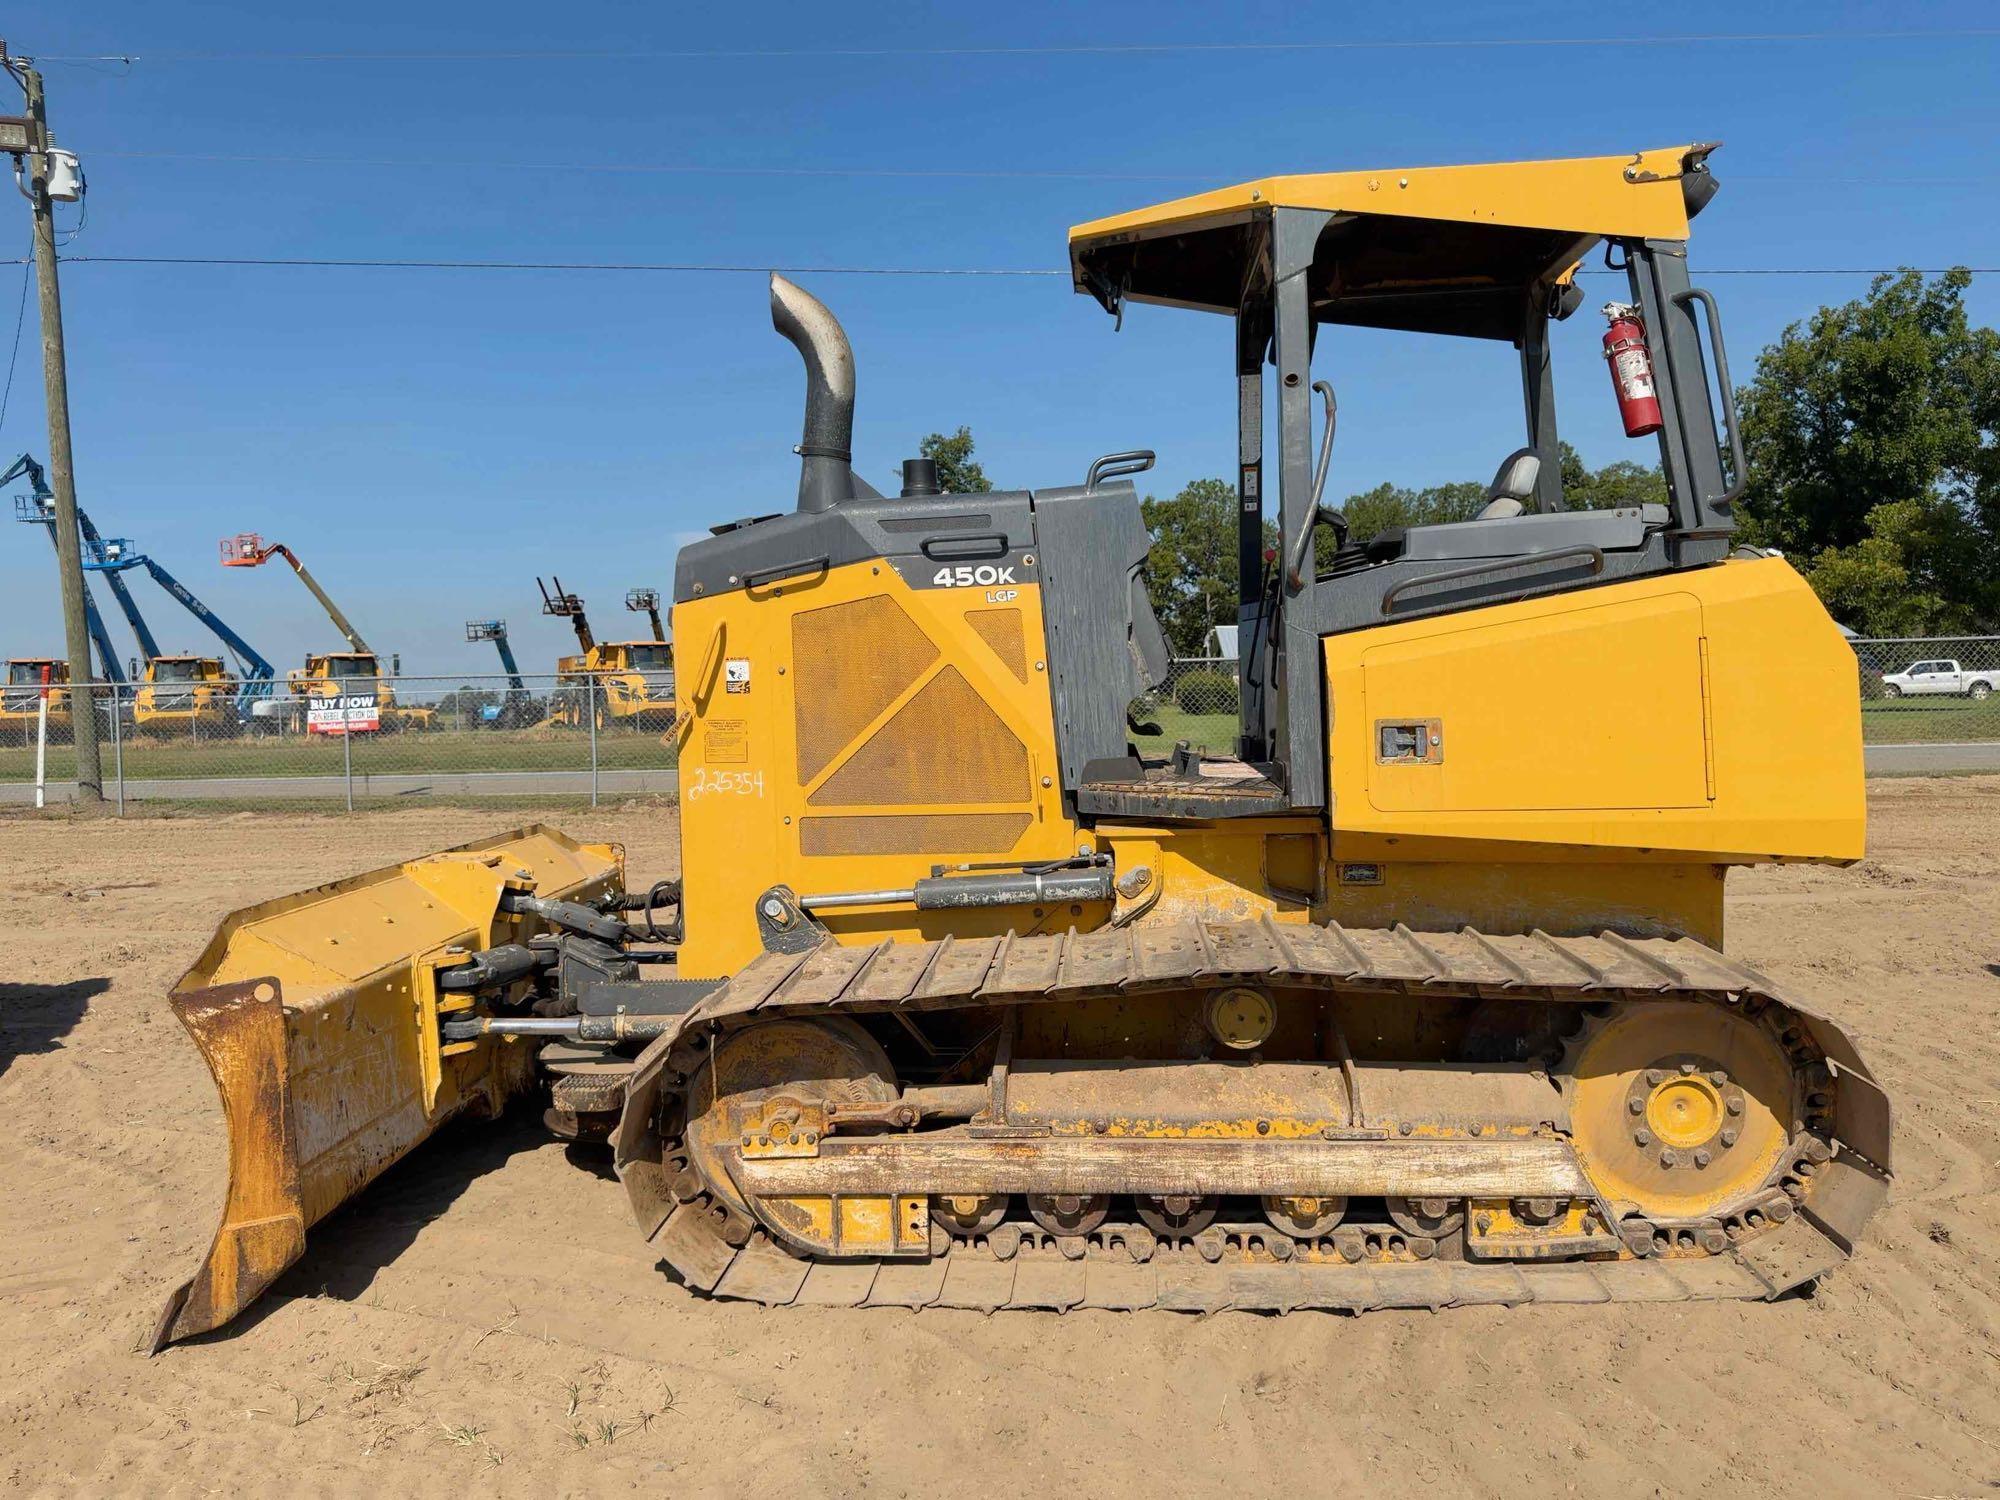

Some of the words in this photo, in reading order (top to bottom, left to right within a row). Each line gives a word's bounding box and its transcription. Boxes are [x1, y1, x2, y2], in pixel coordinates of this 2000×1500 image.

[933, 565, 1017, 587] 450K
[986, 590, 1018, 603] LGP
[310, 698, 336, 710] BUY
[338, 696, 374, 708] NOW
[688, 767, 764, 800] 225354
